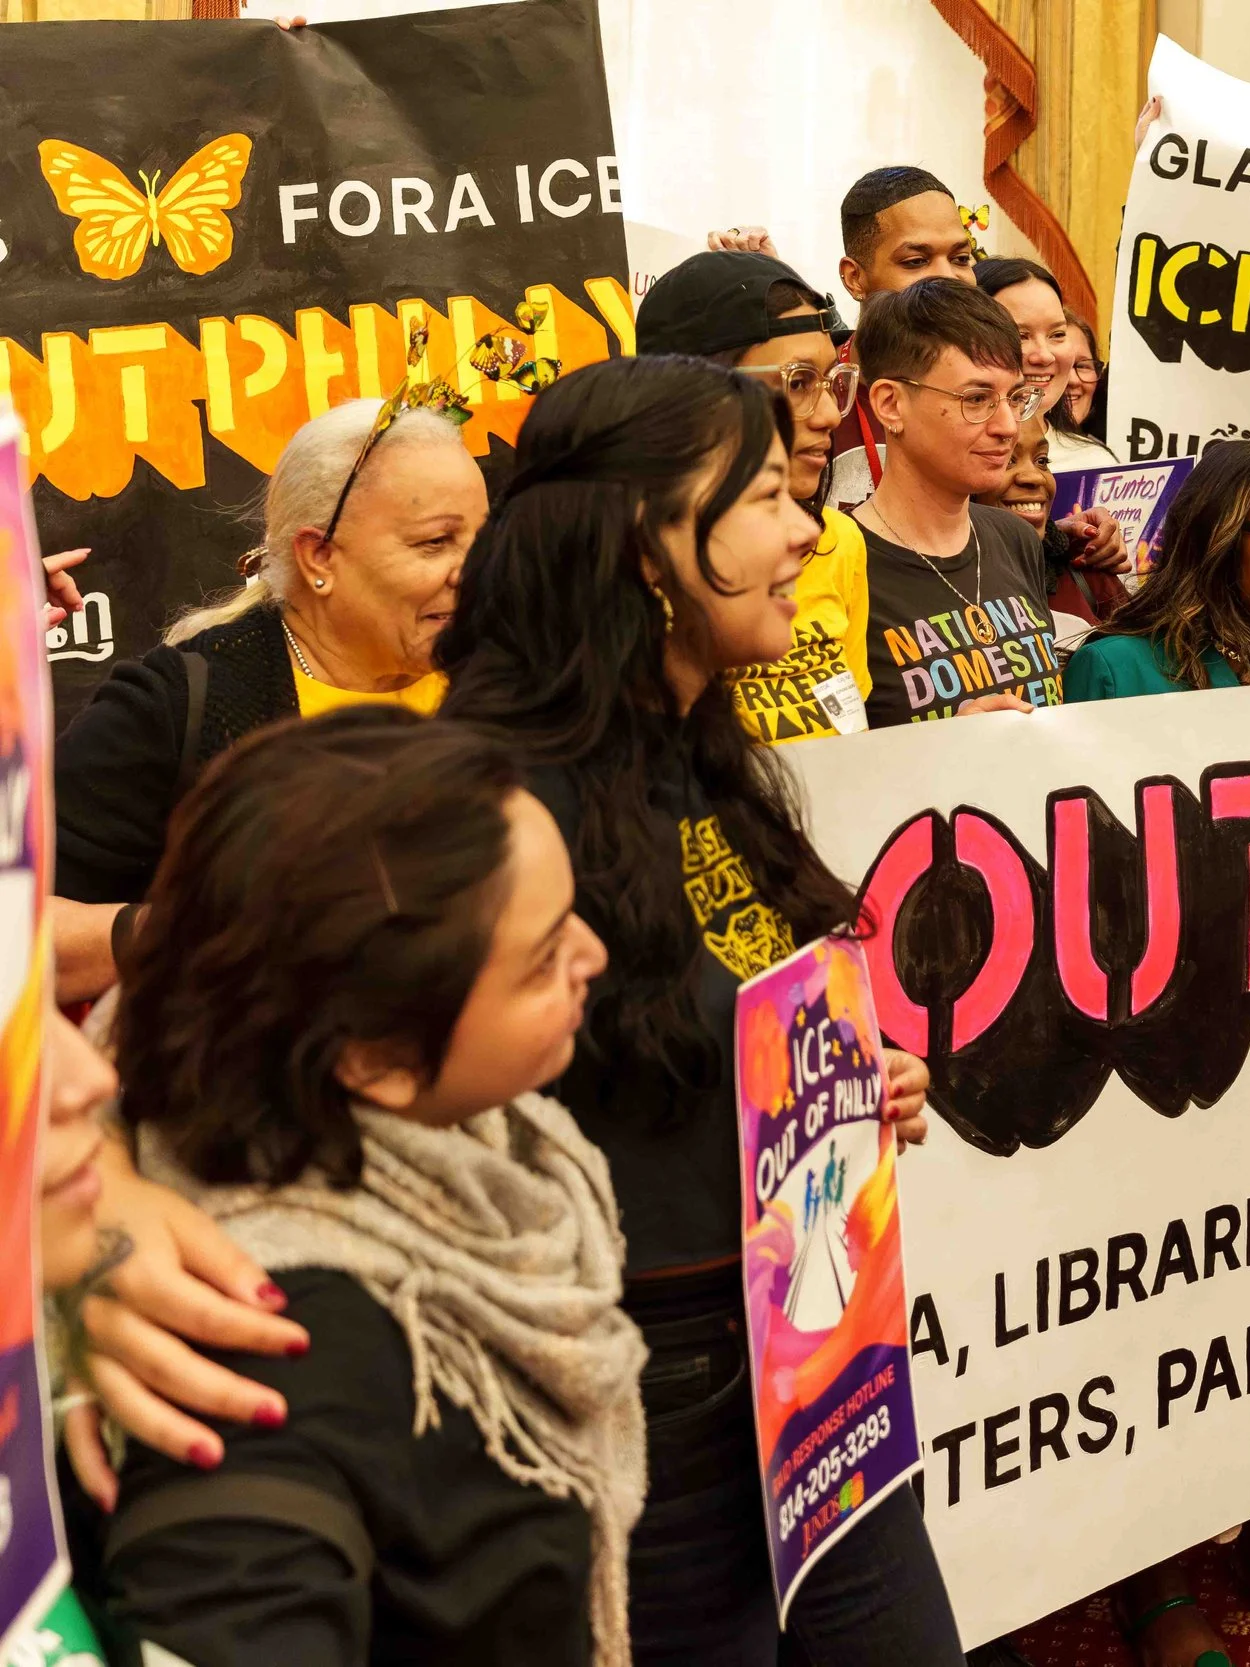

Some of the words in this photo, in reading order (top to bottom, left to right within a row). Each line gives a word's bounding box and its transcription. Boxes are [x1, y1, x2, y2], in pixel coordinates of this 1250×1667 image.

[279, 172, 496, 244] FORA
[515, 156, 624, 223] ICE
[1101, 474, 1166, 503] Juntos
[1107, 505, 1142, 524] ontra
[883, 595, 1047, 667] NATIONAL
[901, 632, 1059, 710] DOMESTIC
[793, 1016, 836, 1099] ICE
[755, 1117, 799, 1202] OUT
[804, 1090, 830, 1140] OF
[833, 1071, 882, 1122] PHILLY
[790, 1404, 846, 1472] RESPONSE
[845, 1362, 896, 1421] HOTLINE
[912, 1374, 1137, 1509] TERS,
